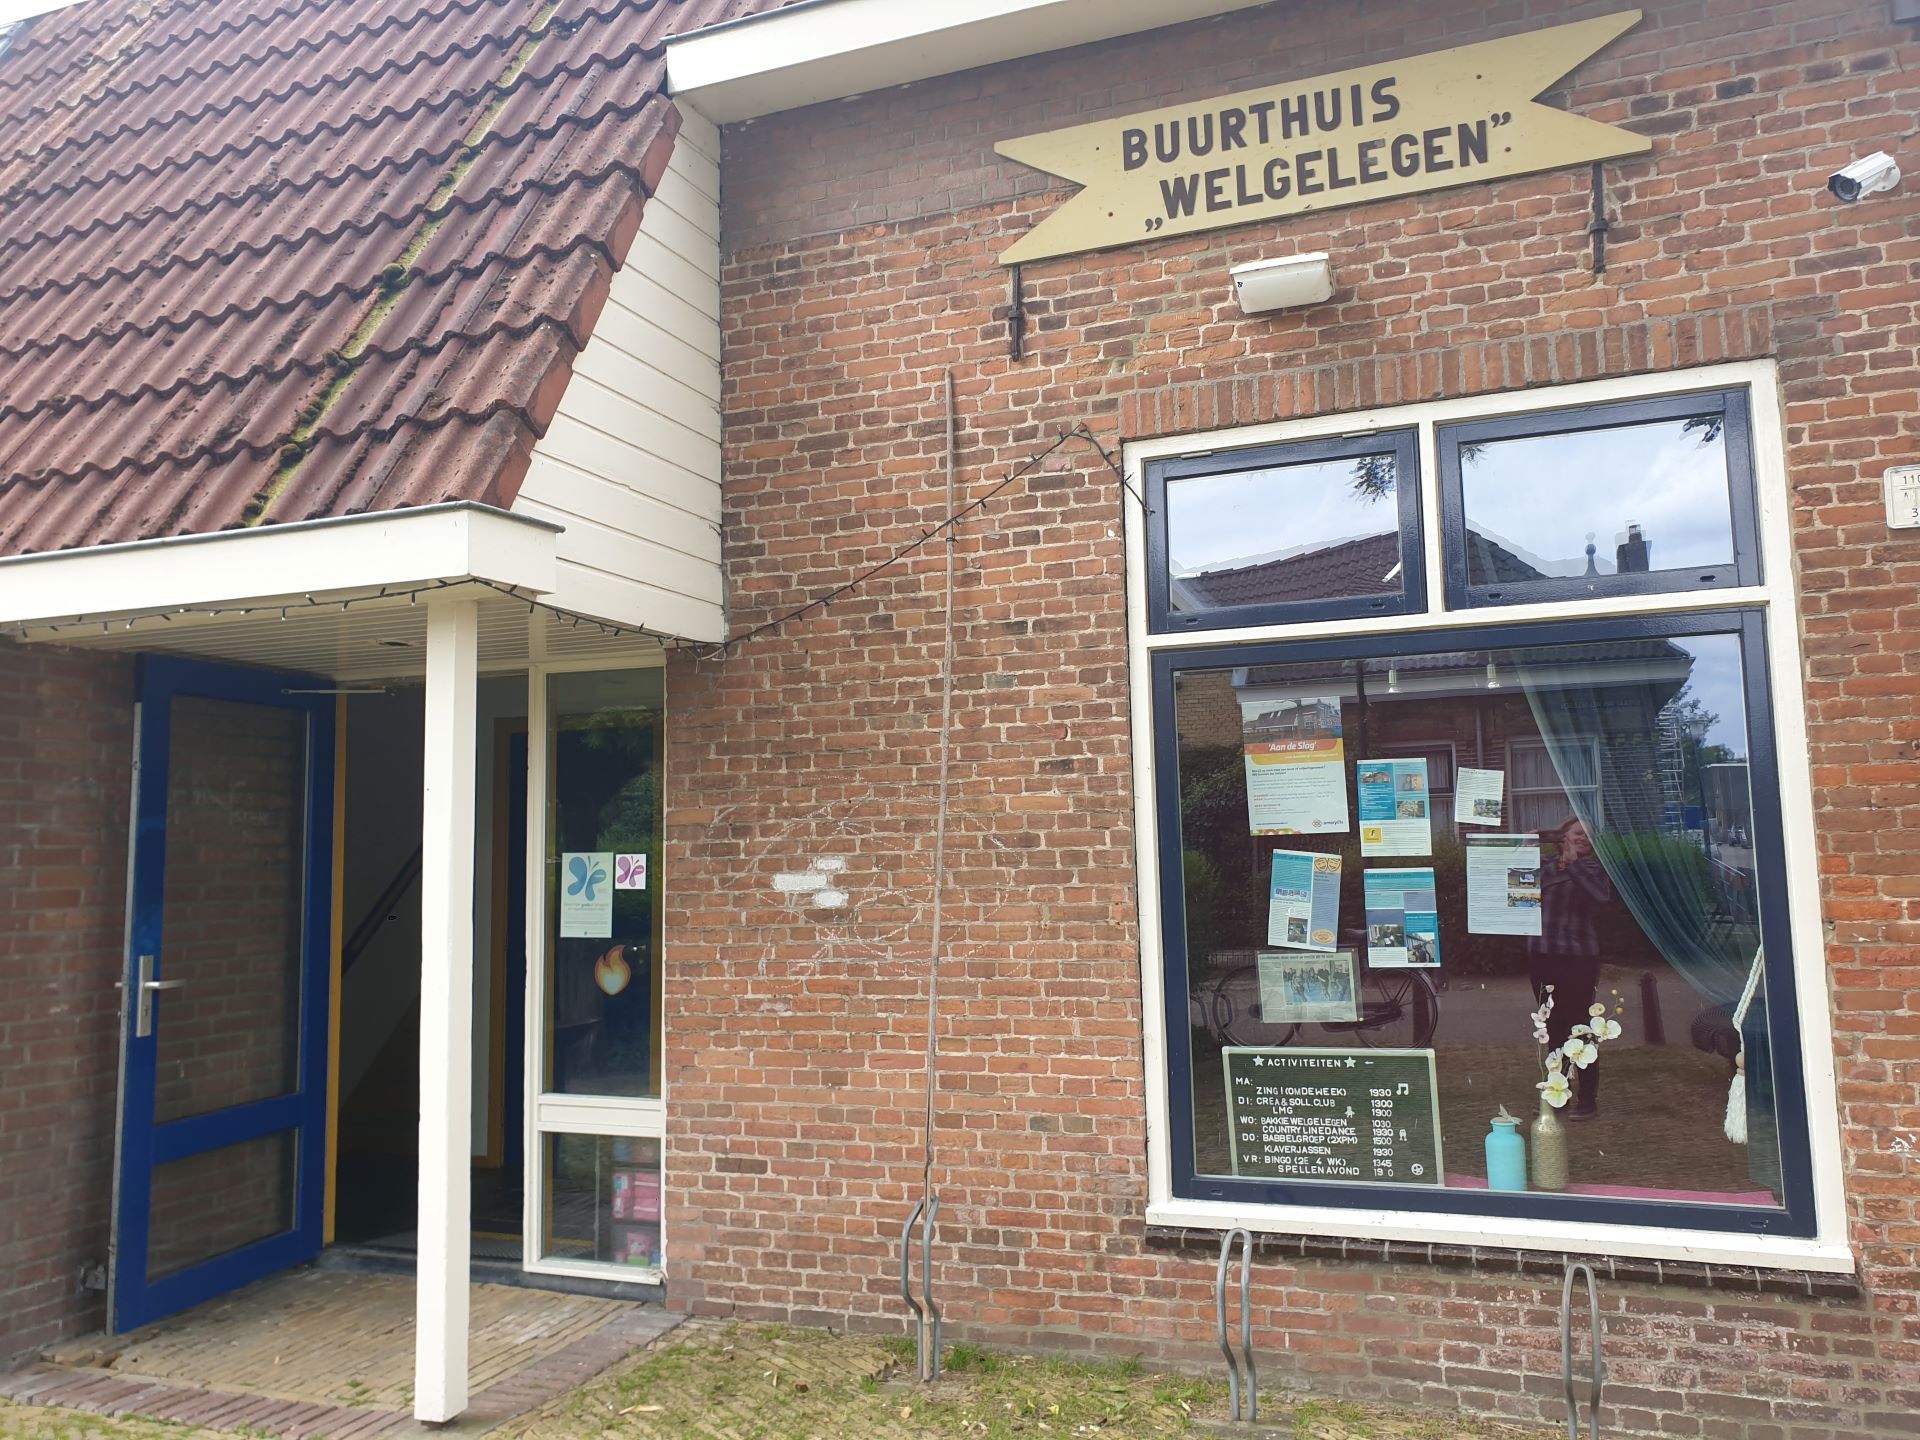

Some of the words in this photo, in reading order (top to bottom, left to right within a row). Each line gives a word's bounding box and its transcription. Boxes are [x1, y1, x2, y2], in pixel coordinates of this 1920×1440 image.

[1122, 77, 1400, 172] BUURTHUIS
[1287, 742, 1297, 750] de
[1267, 1058, 1341, 1068] ACTIVITEITEN
[1235, 1077, 1254, 1086] MA:
[1256, 1087, 1279, 1096] ZING
[1369, 1088, 1392, 1097] 1930
[1238, 1097, 1253, 1106] DI:
[1256, 1097, 1280, 1106] CREA
[1371, 1099, 1393, 1108] 1300
[1272, 1106, 1293, 1115] LMG
[1371, 1108, 1392, 1117] 1900
[1240, 1116, 1257, 1125] WO:
[1371, 1119, 1392, 1128] 1030
[1262, 1125, 1302, 1135] COUNTRY
[1372, 1128, 1394, 1137] 1930
[1242, 1133, 1259, 1142] DO:
[1262, 1134, 1325, 1144] BABBELGROEP
[1372, 1137, 1392, 1145] 1500
[1264, 1144, 1331, 1155] KLAVERJASSEN
[1373, 1148, 1394, 1157] 1930
[1243, 1155, 1262, 1164] VR:
[1264, 1155, 1291, 1164] BINGO
[1315, 1157, 1322, 1165] 4
[1327, 1157, 1346, 1167] WK)
[1373, 1159, 1392, 1168] 1345
